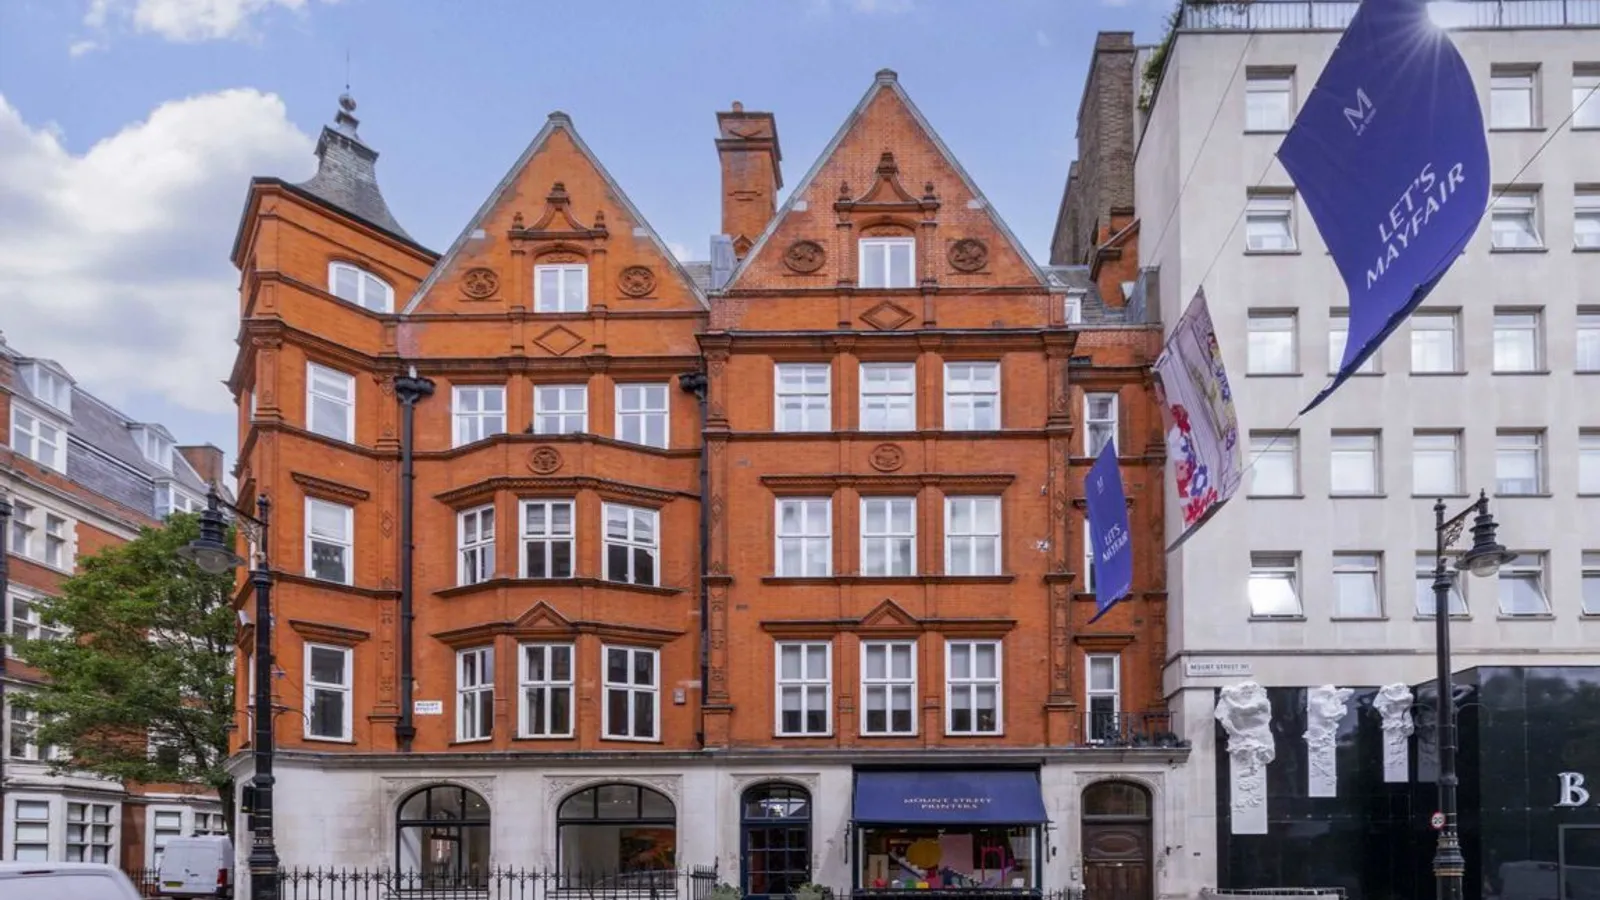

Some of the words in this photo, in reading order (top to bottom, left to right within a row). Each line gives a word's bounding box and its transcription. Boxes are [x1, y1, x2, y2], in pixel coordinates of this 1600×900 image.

[1343, 87, 1373, 130] M
[1366, 162, 1465, 290] MAYFAIR
[1379, 162, 1436, 243] LET'S
[1553, 771, 1600, 807] B
